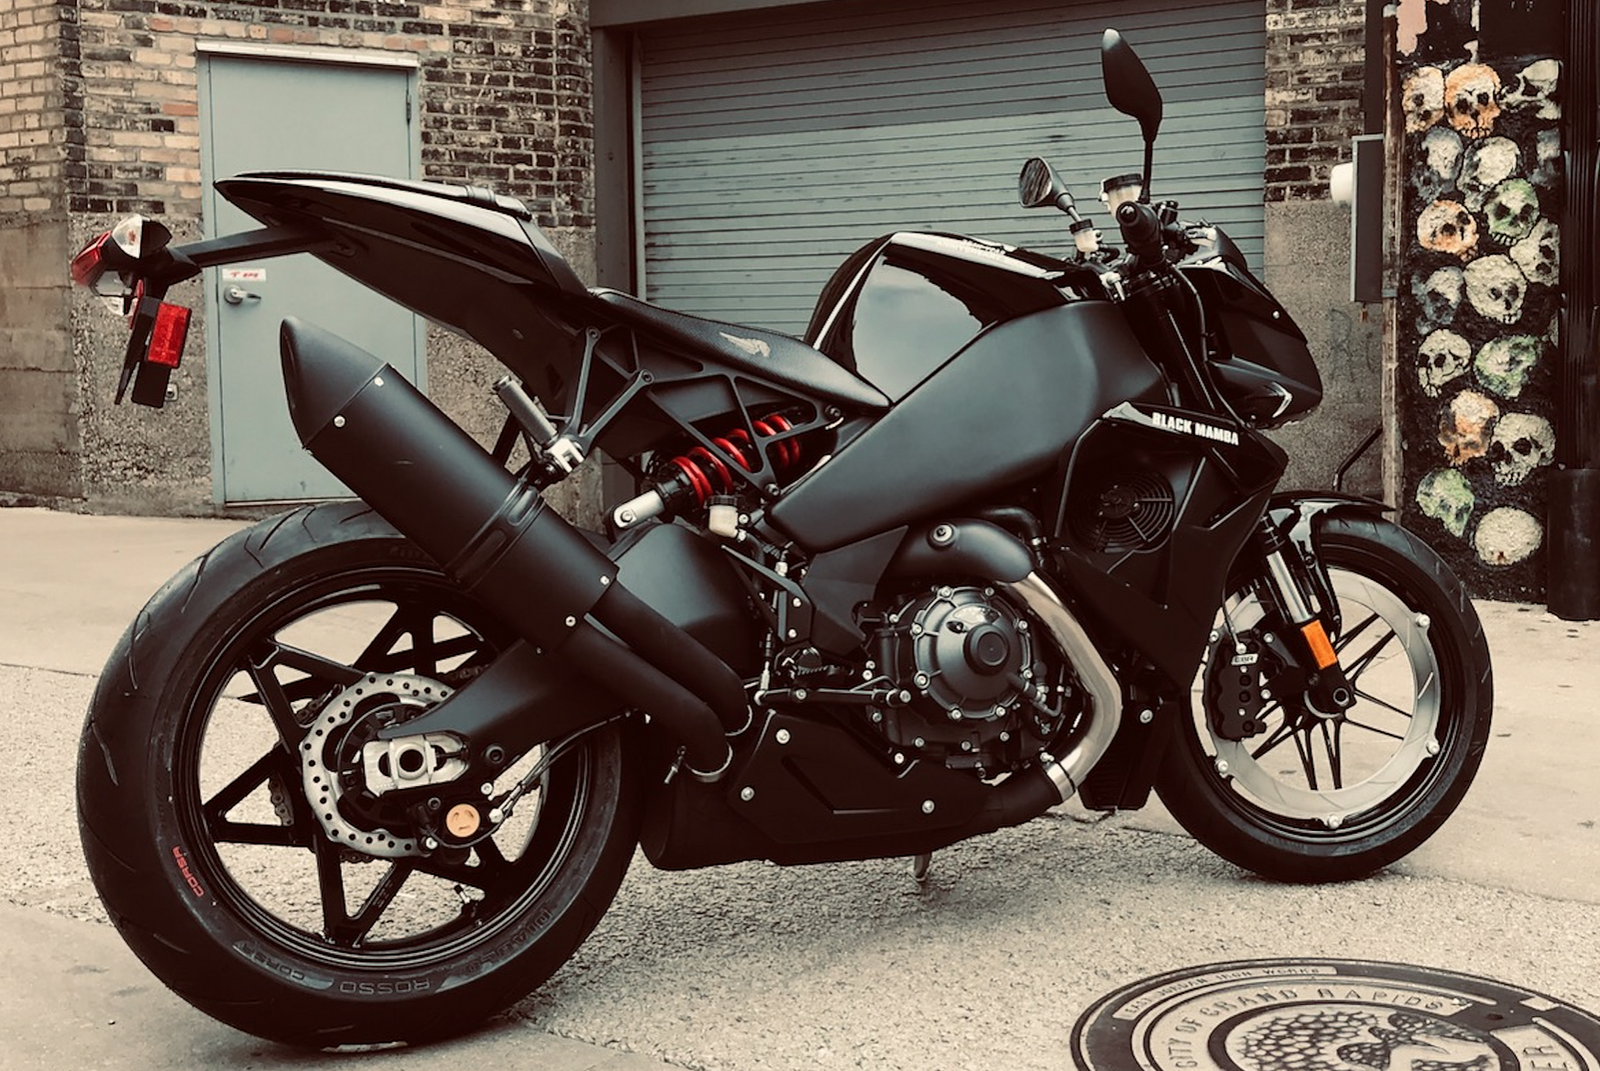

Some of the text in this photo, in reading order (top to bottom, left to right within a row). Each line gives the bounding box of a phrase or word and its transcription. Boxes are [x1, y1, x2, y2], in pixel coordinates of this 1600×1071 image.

[1152, 412, 1239, 446] BLACK MAMBA
[173, 845, 204, 897] CORSA
[340, 978, 430, 995] ROSSO
[1215, 970, 1252, 981] IRON
[1262, 967, 1319, 976] WORKS
[1167, 988, 1444, 1068] CITY OF GRAND RAPIDS
